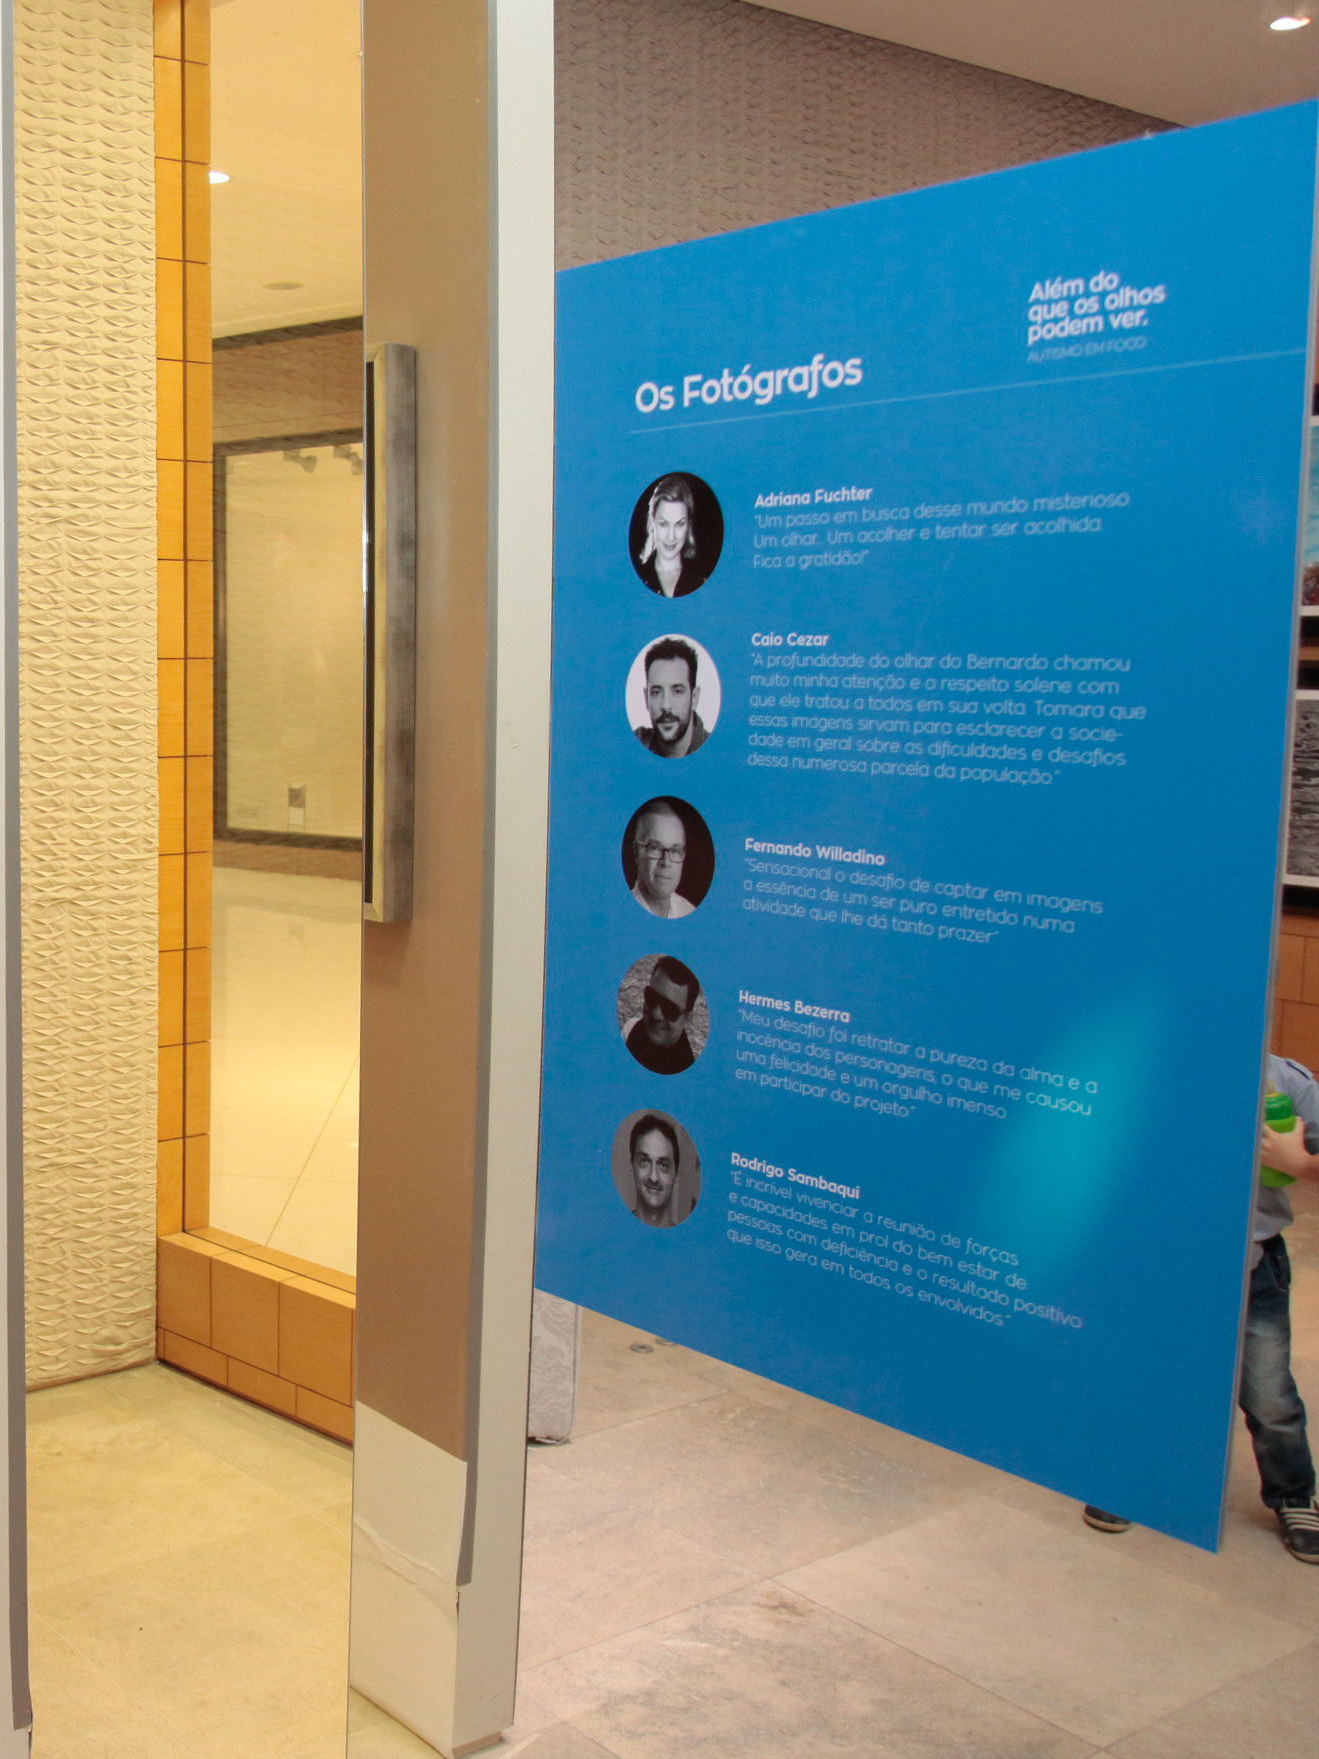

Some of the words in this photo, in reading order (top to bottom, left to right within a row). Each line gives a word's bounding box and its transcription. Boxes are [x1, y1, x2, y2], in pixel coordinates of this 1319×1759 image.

[1028, 301, 1069, 324] que
[1074, 296, 1099, 315] os
[1104, 284, 1166, 310] olhos
[1029, 276, 1084, 303] Além
[1089, 270, 1119, 292] do
[1027, 316, 1103, 346] podem
[1109, 309, 1148, 329] ver.
[635, 383, 674, 413] Os
[682, 355, 863, 408] Fotógrafos
[755, 492, 810, 508] Adriana
[815, 486, 873, 503] Fuchter
[786, 512, 829, 528] passo
[834, 510, 857, 523] em
[862, 507, 909, 521] busca
[913, 503, 961, 518] desse
[967, 498, 1028, 516] mundo
[754, 535, 777, 548] Um
[828, 530, 853, 544] Um
[858, 527, 915, 542] acolher
[920, 527, 930, 539] e
[936, 522, 986, 539] tentar
[991, 522, 1018, 536] ser
[753, 554, 781, 568] Fica
[785, 556, 794, 567] a
[752, 632, 782, 646] Caio
[787, 632, 829, 646] Cezar
[767, 652, 864, 669] profundidade
[869, 653, 889, 667] do
[939, 653, 962, 669] do
[967, 653, 1048, 670] Bernardo
[1054, 654, 1130, 671] chamou
[750, 674, 789, 687] muito
[794, 674, 837, 688] minha
[842, 674, 905, 691] atenção
[910, 678, 920, 689] e
[925, 678, 936, 690] o
[941, 677, 1009, 693] respeito
[1014, 676, 1072, 693] solene
[1078, 680, 1120, 694] com
[750, 695, 775, 708] que
[780, 694, 800, 707] ele
[805, 694, 848, 709] tratou
[854, 697, 864, 709] a
[869, 696, 912, 712] todos
[917, 700, 943, 712] em
[948, 700, 978, 714] sua
[1035, 700, 1105, 718] Tomara
[1110, 706, 1146, 720] que
[749, 715, 788, 727] essas
[792, 715, 853, 731] imagens
[858, 717, 909, 732] sirvam
[914, 720, 951, 735] para
[956, 721, 1046, 738] esclarecer
[1051, 727, 1063, 739] a
[748, 732, 783, 747] dade
[788, 736, 810, 748] em
[815, 737, 851, 751] geral
[857, 738, 899, 753] sobre
[905, 742, 923, 754] as
[929, 740, 1027, 760] dificuldades
[1032, 748, 1043, 761] e
[1048, 747, 1126, 767] desafios
[748, 752, 788, 767] dessa
[792, 756, 867, 773] numerosa
[871, 761, 929, 776] parcela
[934, 762, 956, 779] da
[745, 838, 811, 857] Fernando
[816, 845, 885, 865] Willadino
[743, 880, 752, 890] a
[757, 881, 816, 899] essência
[820, 888, 839, 901] de
[843, 892, 866, 905] um
[871, 895, 895, 908] ser
[900, 900, 937, 915] puro
[942, 904, 1018, 925] entretido
[1023, 914, 1075, 933] numa
[835, 871, 845, 882] o
[850, 871, 905, 891] desafio
[910, 877, 930, 892] de
[935, 882, 989, 899] captar
[994, 889, 1022, 903] em
[1027, 892, 1103, 914] imagens
[743, 899, 805, 917] atividade
[810, 907, 836, 921] que
[841, 909, 863, 925] lhe
[867, 914, 887, 929] dá
[892, 916, 934, 935] tanto
[739, 990, 790, 1011] Hermes
[795, 1000, 850, 1023] Bezerra
[737, 1030, 800, 1053] inocência
[805, 1042, 830, 1059] dos
[836, 1051, 936, 1084] personagens,
[942, 1074, 953, 1086] o
[958, 1077, 988, 1093] que
[994, 1084, 1021, 1100] me
[1026, 1092, 1092, 1115] causou
[774, 1017, 824, 1038] desafio
[828, 1026, 847, 1042] foi
[852, 1033, 910, 1054] retratar
[915, 1047, 925, 1059] a
[930, 1049, 988, 1071] pureza
[993, 1061, 1015, 1077] da
[1020, 1067, 1063, 1087] alma
[1068, 1078, 1080, 1090] e
[1086, 1081, 1098, 1094] a
[735, 1069, 756, 1082] em
[761, 1074, 826, 1098] participar
[831, 1088, 850, 1103] do
[736, 1050, 765, 1065] uma
[770, 1054, 836, 1080] felicidade
[841, 1072, 850, 1083] e
[854, 1076, 878, 1089] um
[882, 1082, 942, 1104] orgulho
[947, 1093, 1006, 1118] imenso
[731, 1152, 783, 1178] Rodrigo
[788, 1168, 860, 1199] Sambaqui
[746, 1175, 792, 1199] incrível
[797, 1192, 859, 1218] vivenciar
[863, 1212, 873, 1223] a
[878, 1216, 935, 1241] reunião
[941, 1232, 961, 1249] de
[965, 1238, 1019, 1266] forças
[729, 1192, 737, 1202] e
[741, 1196, 828, 1230] capacidades
[832, 1223, 855, 1238] em
[860, 1231, 889, 1248] prol
[892, 1240, 913, 1255] do
[918, 1245, 953, 1267] bem
[958, 1261, 999, 1281] estar
[1005, 1273, 1027, 1290] de
[727, 1229, 751, 1245] que
[756, 1236, 781, 1254] isso
[786, 1248, 817, 1266] gera
[821, 1259, 844, 1274] em
[849, 1265, 890, 1289] todos
[895, 1283, 913, 1297] os
[728, 1211, 782, 1235] pessoas
[787, 1229, 817, 1246] com
[821, 1238, 898, 1271] deficiência
[902, 1265, 912, 1275] e
[917, 1269, 927, 1280] o
[932, 1273, 1009, 1306] resultado
[1014, 1299, 1082, 1328] positivo
